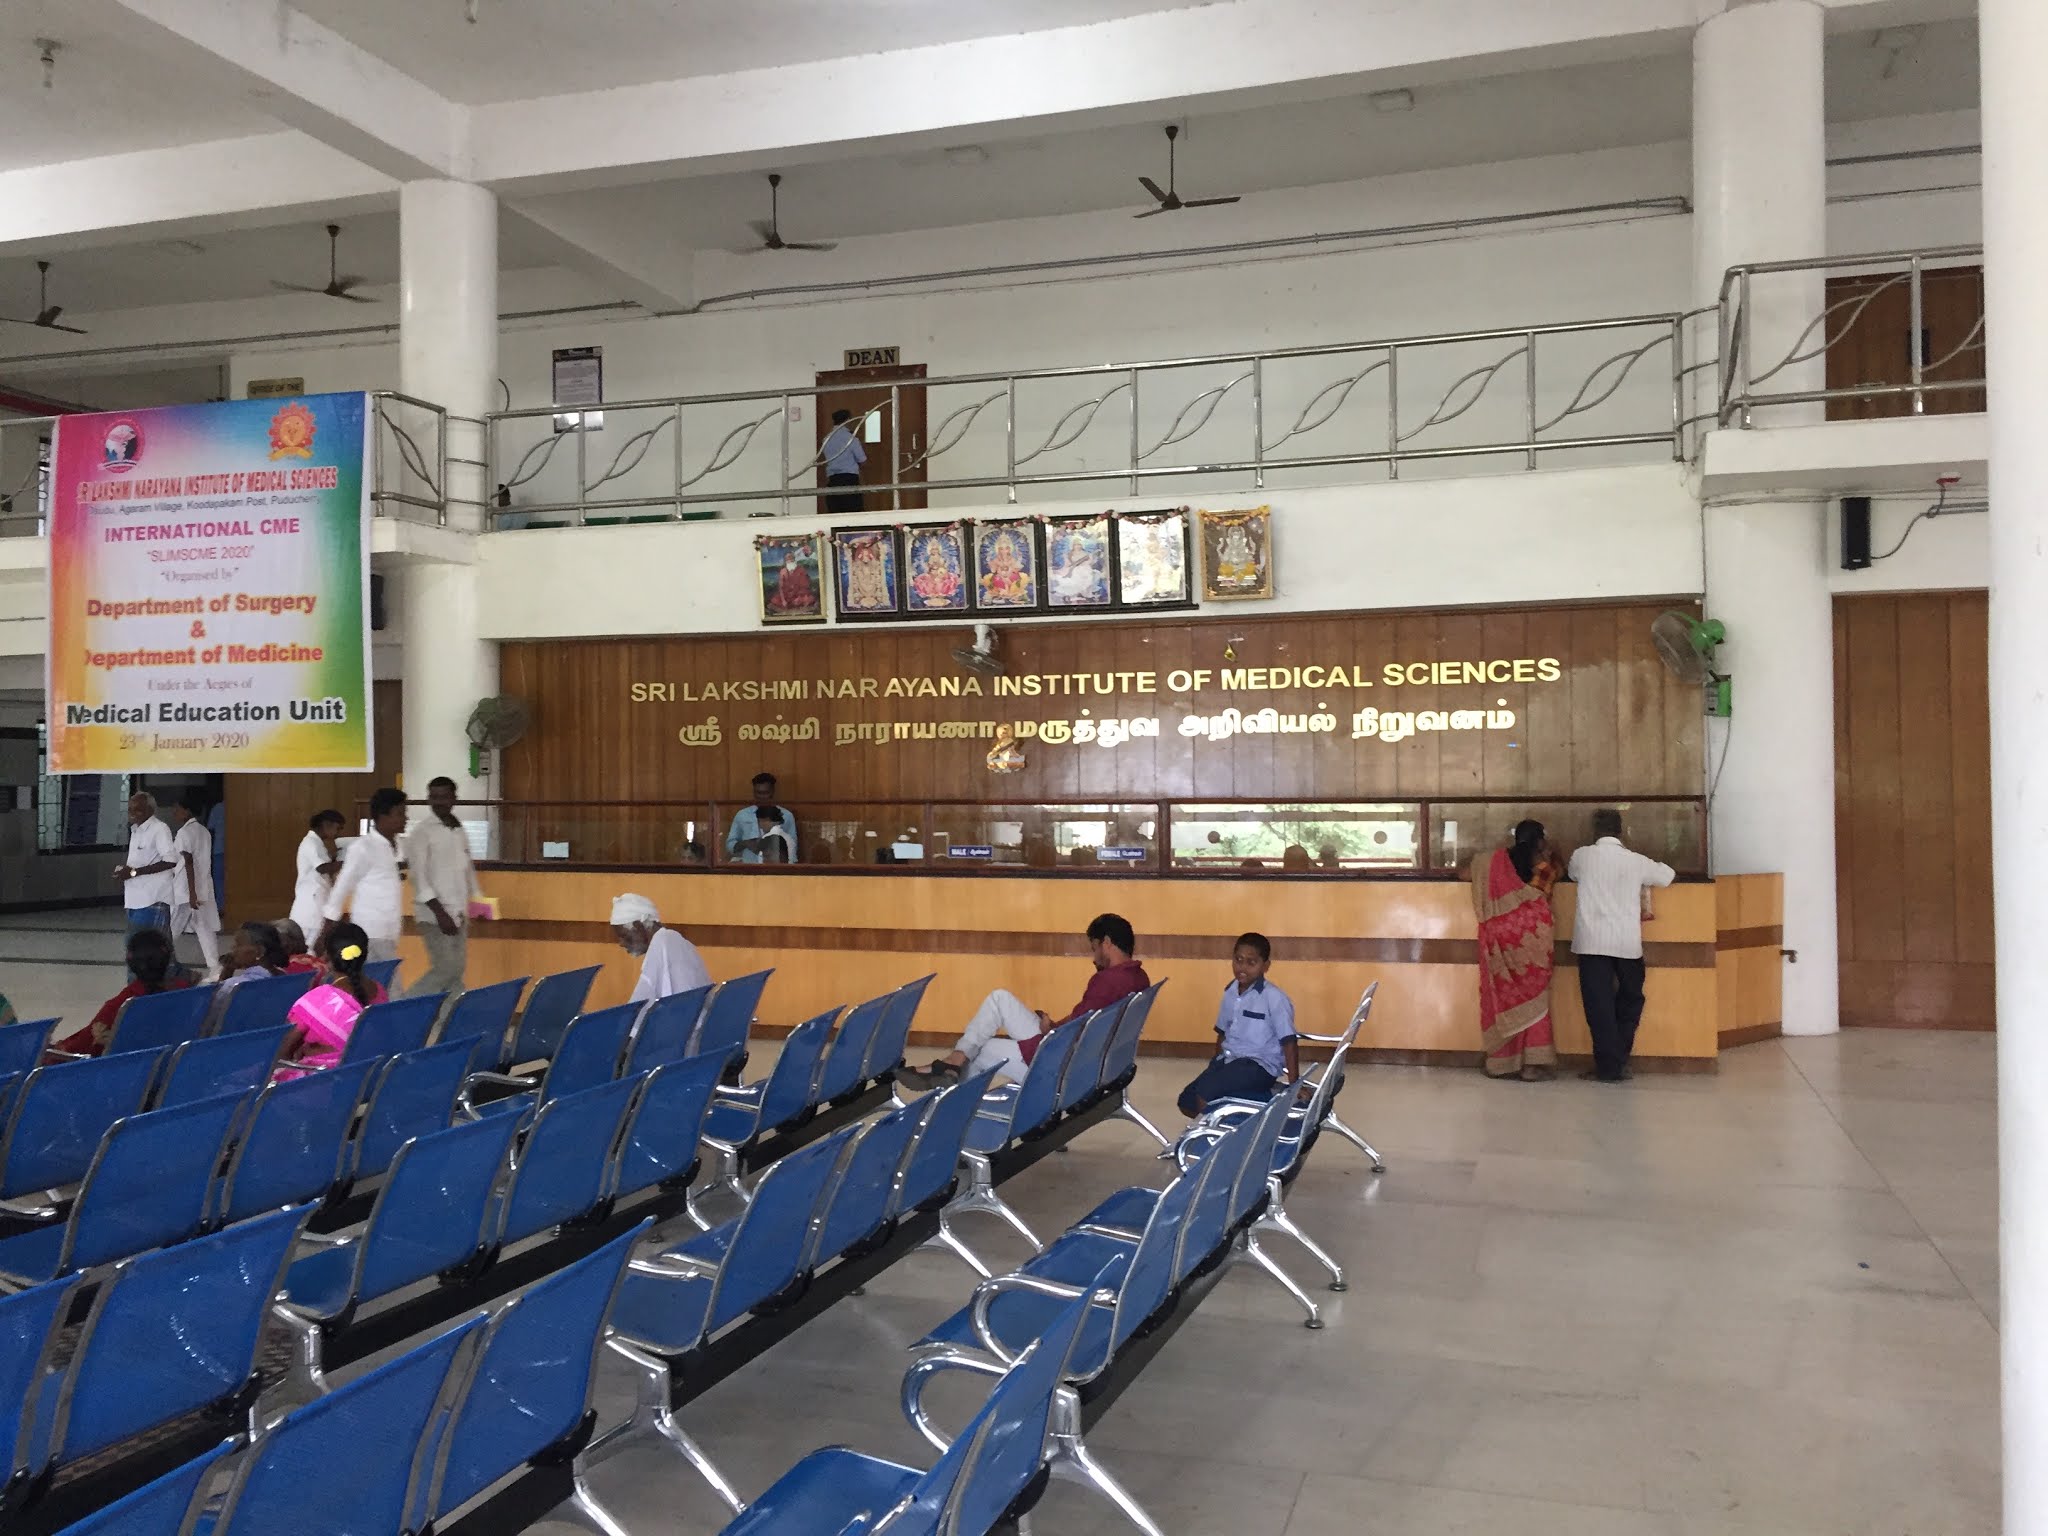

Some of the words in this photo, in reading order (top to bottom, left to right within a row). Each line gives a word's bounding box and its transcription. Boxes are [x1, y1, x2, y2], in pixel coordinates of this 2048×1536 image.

[848, 349, 896, 367] DEAN
[92, 479, 131, 502] LAKSHMI
[134, 476, 182, 499] NARAYANA
[184, 472, 230, 496] INSTITUTE
[232, 472, 245, 493] OF
[246, 470, 287, 493] MEDICAL
[290, 467, 338, 490] SCIENCES
[105, 520, 254, 543] INTERNATIONAL
[260, 518, 300, 535] CME
[87, 598, 204, 621] Department
[209, 594, 231, 613] of
[236, 593, 317, 615] Surgery
[189, 620, 206, 640] &
[201, 645, 223, 664] of
[228, 643, 323, 663] Medicine
[241, 677, 254, 689] of
[631, 682, 676, 703] SRI
[683, 679, 809, 702] LAKSHMI
[993, 671, 1157, 697] INSTITUTE
[1167, 669, 1212, 694] OF
[1221, 665, 1373, 691] MEDICAL
[1382, 658, 1562, 686] SCIENCES
[158, 701, 281, 723] Education
[290, 700, 345, 721] Unit
[1014, 708, 1160, 748] மருத்துவ
[1178, 702, 1337, 742] அறிவியல்
[1352, 698, 1516, 743] நிறுவனம்
[150, 732, 207, 752] January
[211, 732, 250, 749] 2020
